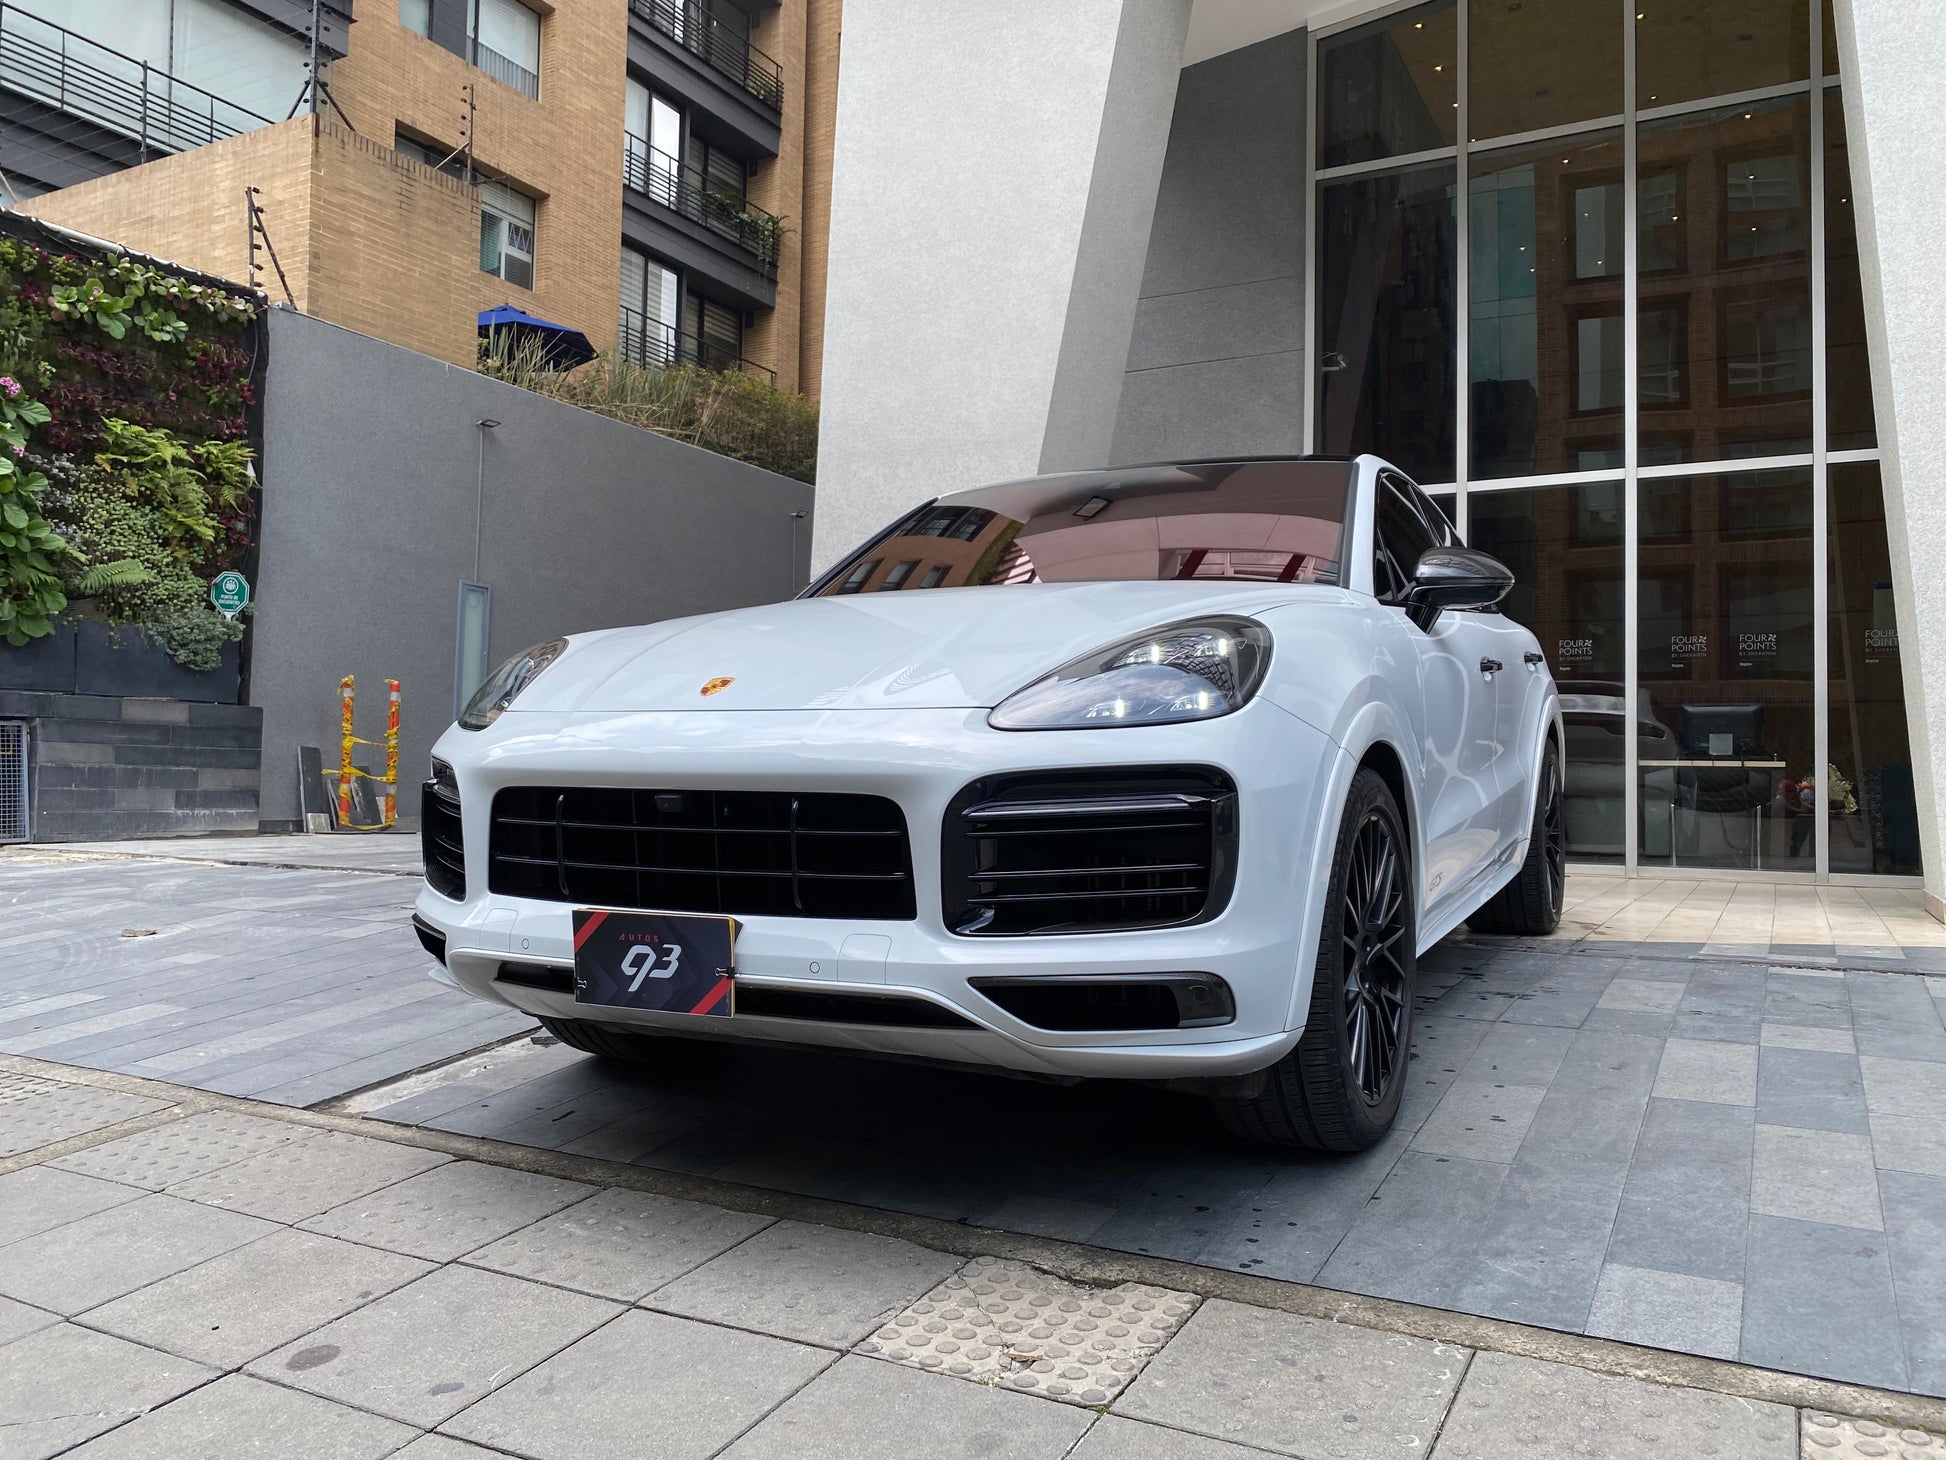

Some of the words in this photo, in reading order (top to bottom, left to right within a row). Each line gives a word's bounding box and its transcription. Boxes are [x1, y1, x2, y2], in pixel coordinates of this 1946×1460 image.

[1740, 633, 1768, 641] FOUR
[1865, 629, 1896, 638] FOUR
[1559, 639, 1584, 648] FOUR
[1671, 635, 1698, 644] FOUR
[1865, 637, 1899, 647] POINT
[1671, 643, 1707, 652] POINTS
[1739, 642, 1777, 650] POINTS
[1559, 647, 1592, 656] POINTS
[619, 933, 660, 943] AUTOS
[620, 944, 682, 993] 93
